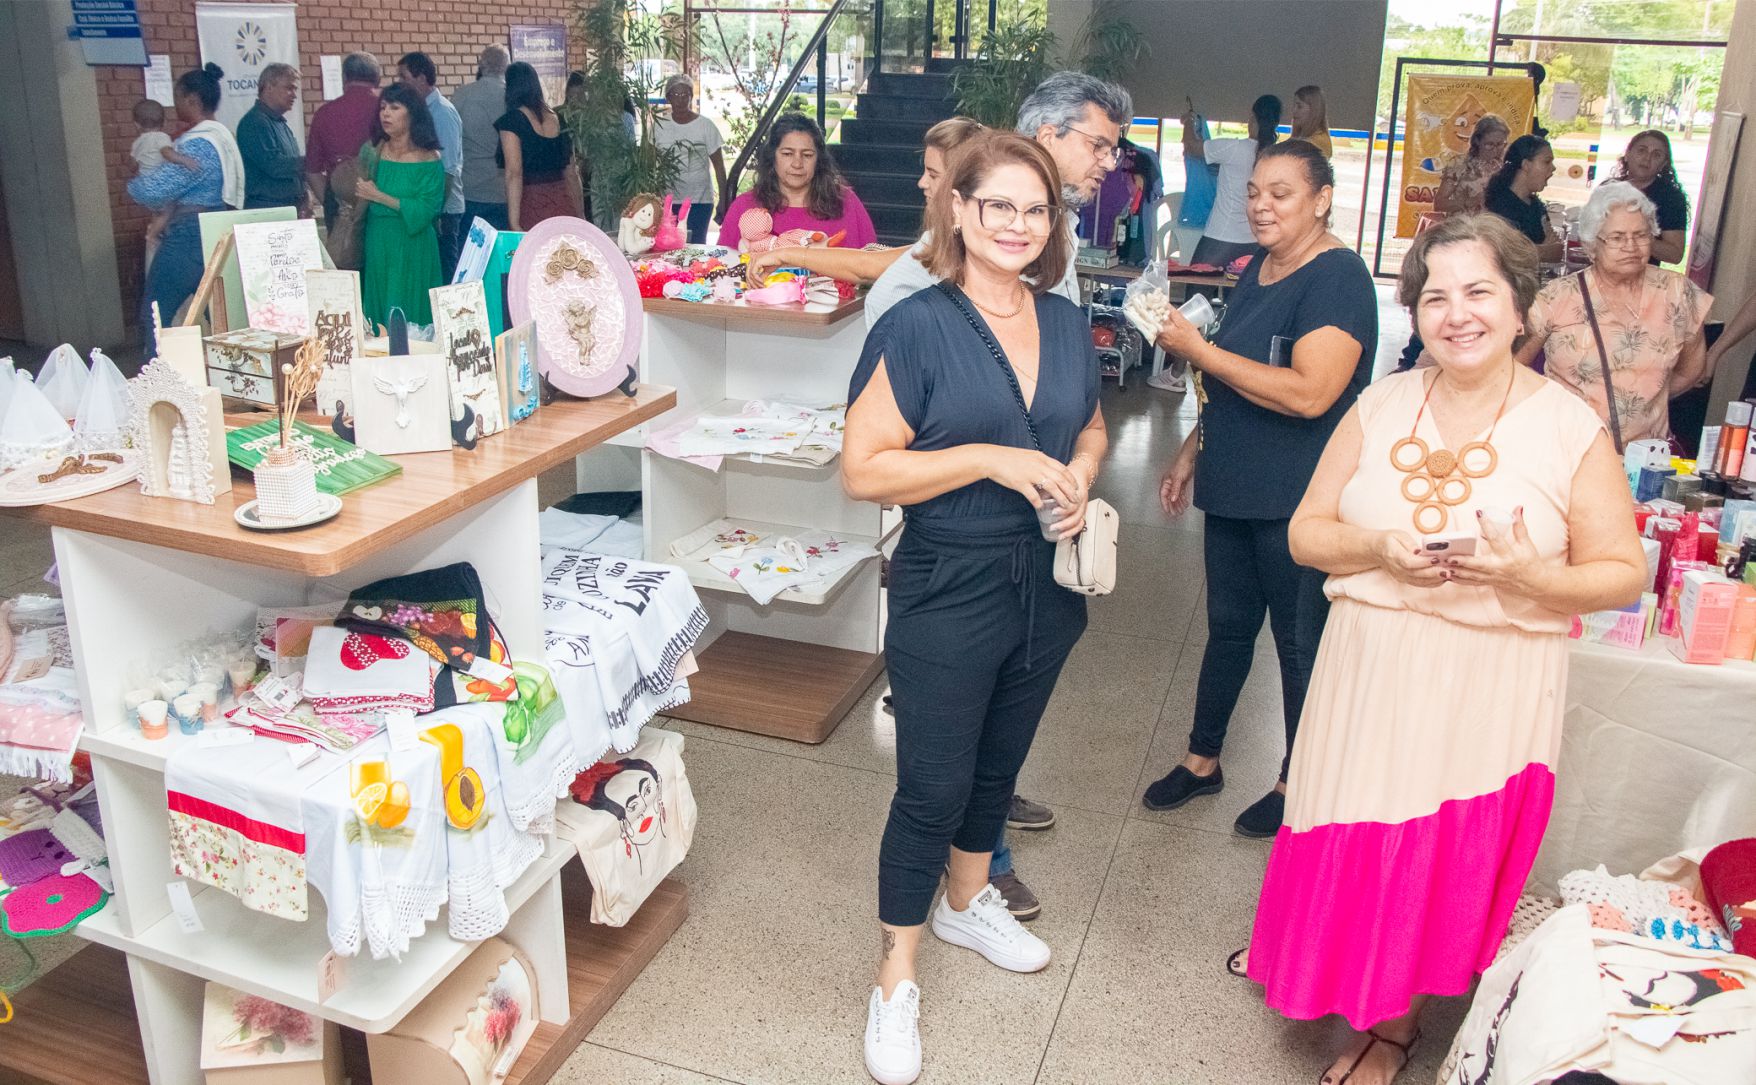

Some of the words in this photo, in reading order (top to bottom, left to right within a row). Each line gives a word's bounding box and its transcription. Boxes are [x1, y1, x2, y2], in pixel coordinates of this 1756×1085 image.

[1423, 87, 1445, 105] Quem
[1507, 100, 1521, 126] indica
[1405, 186, 1438, 203] SA
[614, 571, 671, 617] LAVA
